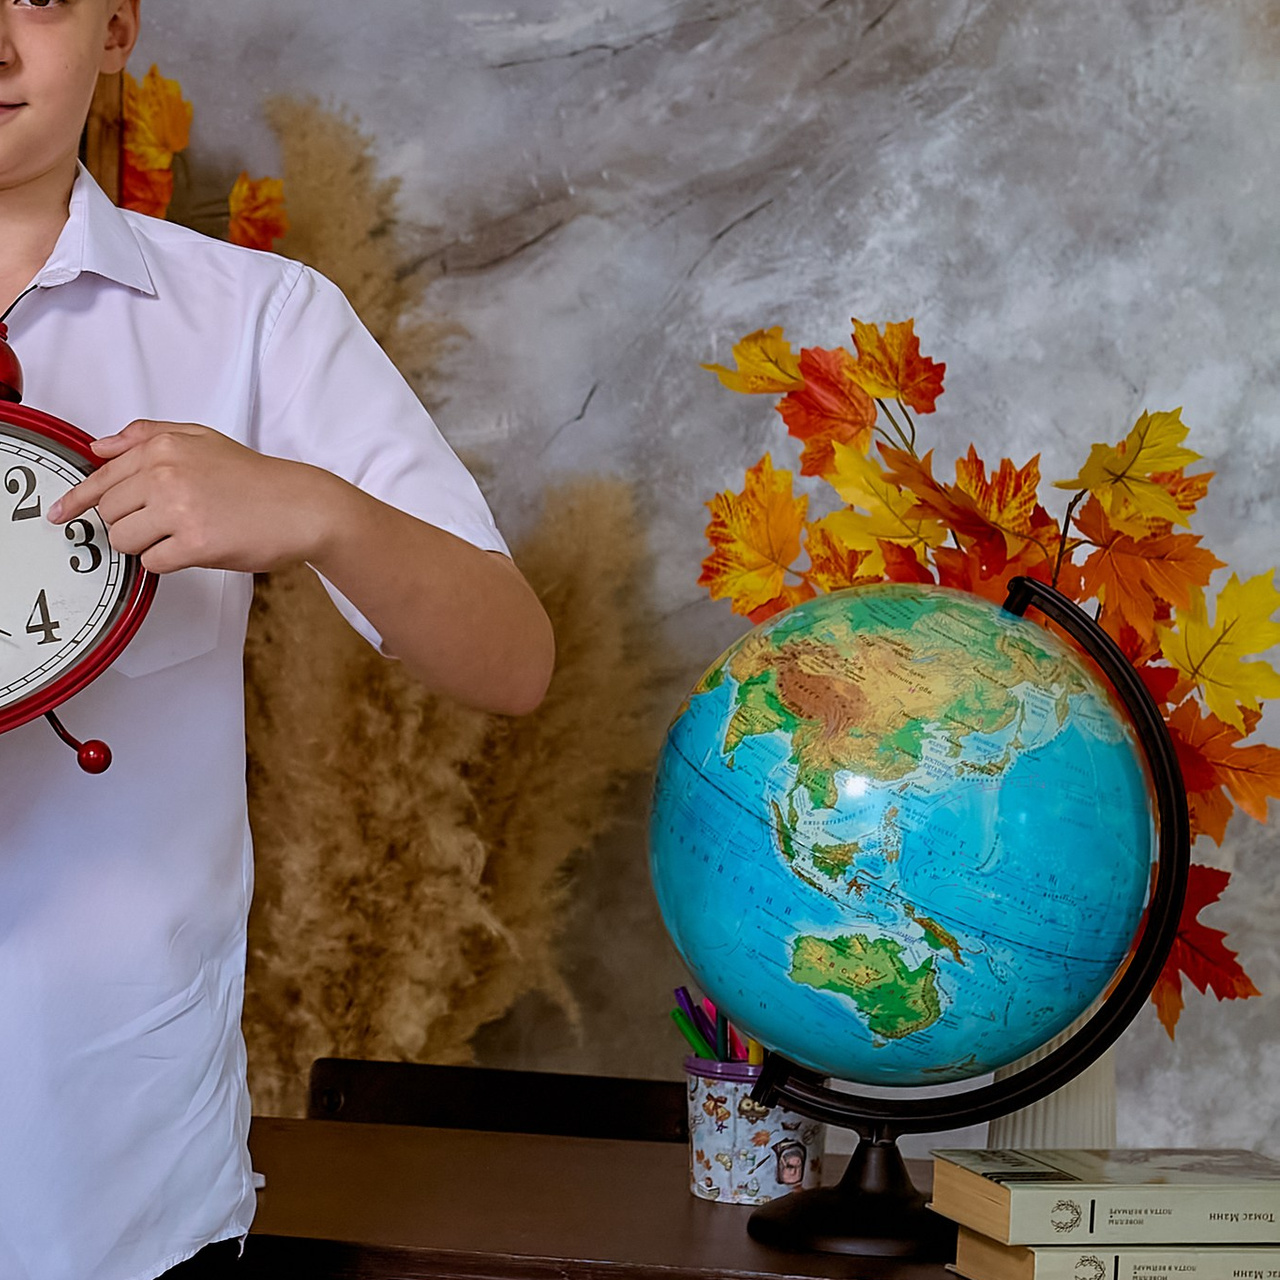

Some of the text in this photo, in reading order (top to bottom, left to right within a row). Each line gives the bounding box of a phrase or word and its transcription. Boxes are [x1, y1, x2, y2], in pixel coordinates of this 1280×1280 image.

[4, 465, 42, 521] 2
[64, 517, 102, 574] 3
[25, 588, 63, 646] 4
[1209, 1212, 1275, 1223] Томас Манн
[1233, 1270, 1263, 1280] Манн
